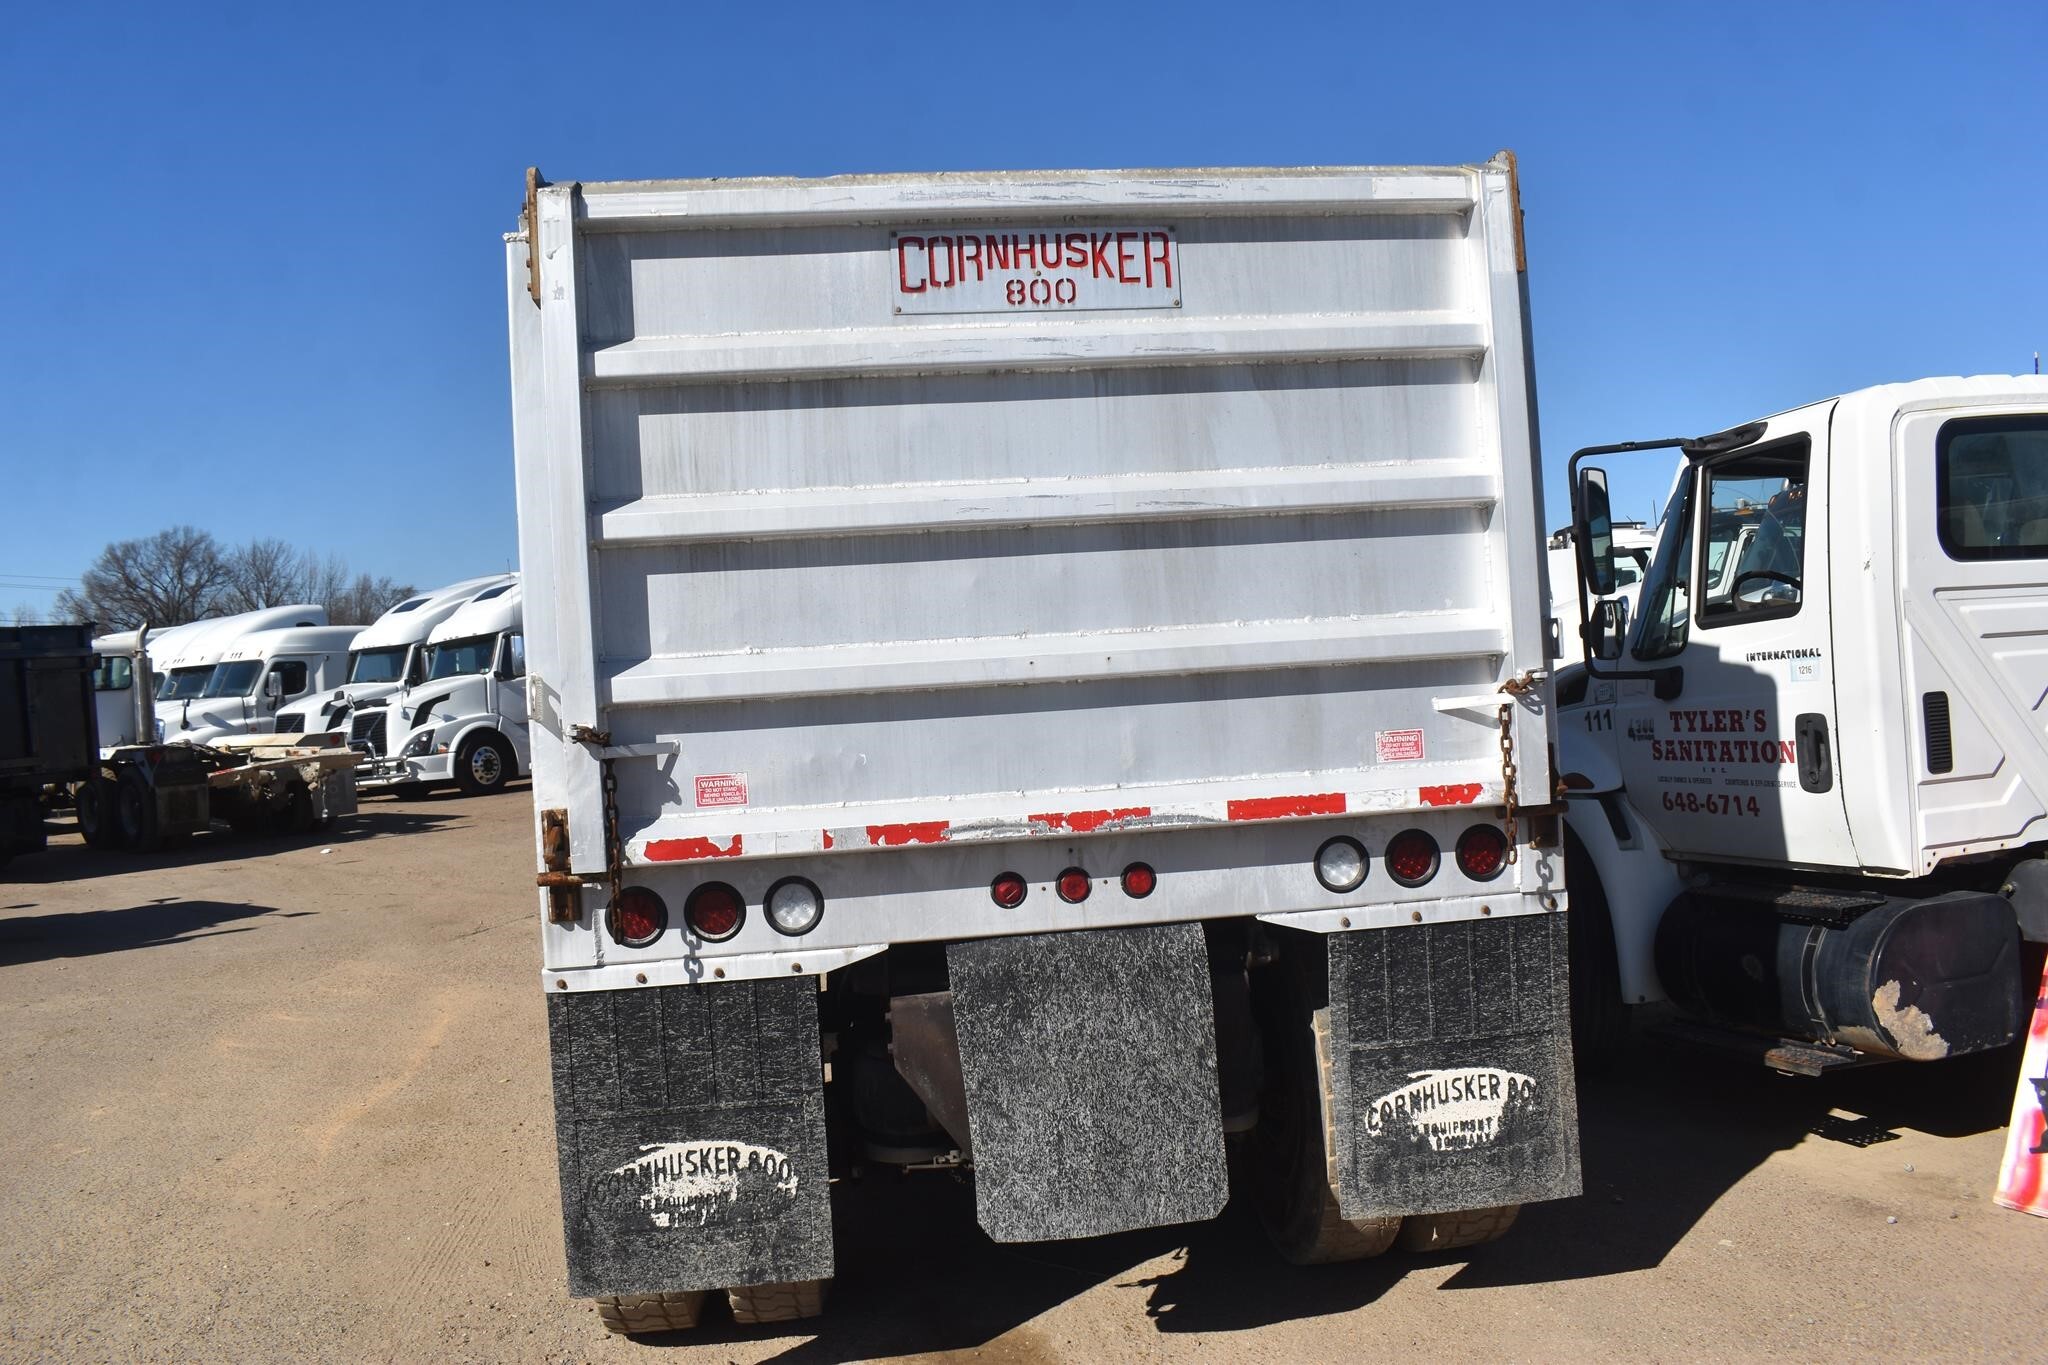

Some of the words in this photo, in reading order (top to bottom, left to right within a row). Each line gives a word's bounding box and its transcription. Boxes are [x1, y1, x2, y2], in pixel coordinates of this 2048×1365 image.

[897, 231, 1172, 294] CORNHUSKER
[1005, 277, 1077, 305] 800
[1746, 648, 1822, 662] INTERNATIONAL
[1584, 709, 1613, 732] 111
[1669, 709, 1767, 733] TYLER'S
[1652, 739, 1795, 764] SANITATION
[1662, 791, 1761, 817] 648-6714
[1367, 1073, 1501, 1132] CORNHUSKER
